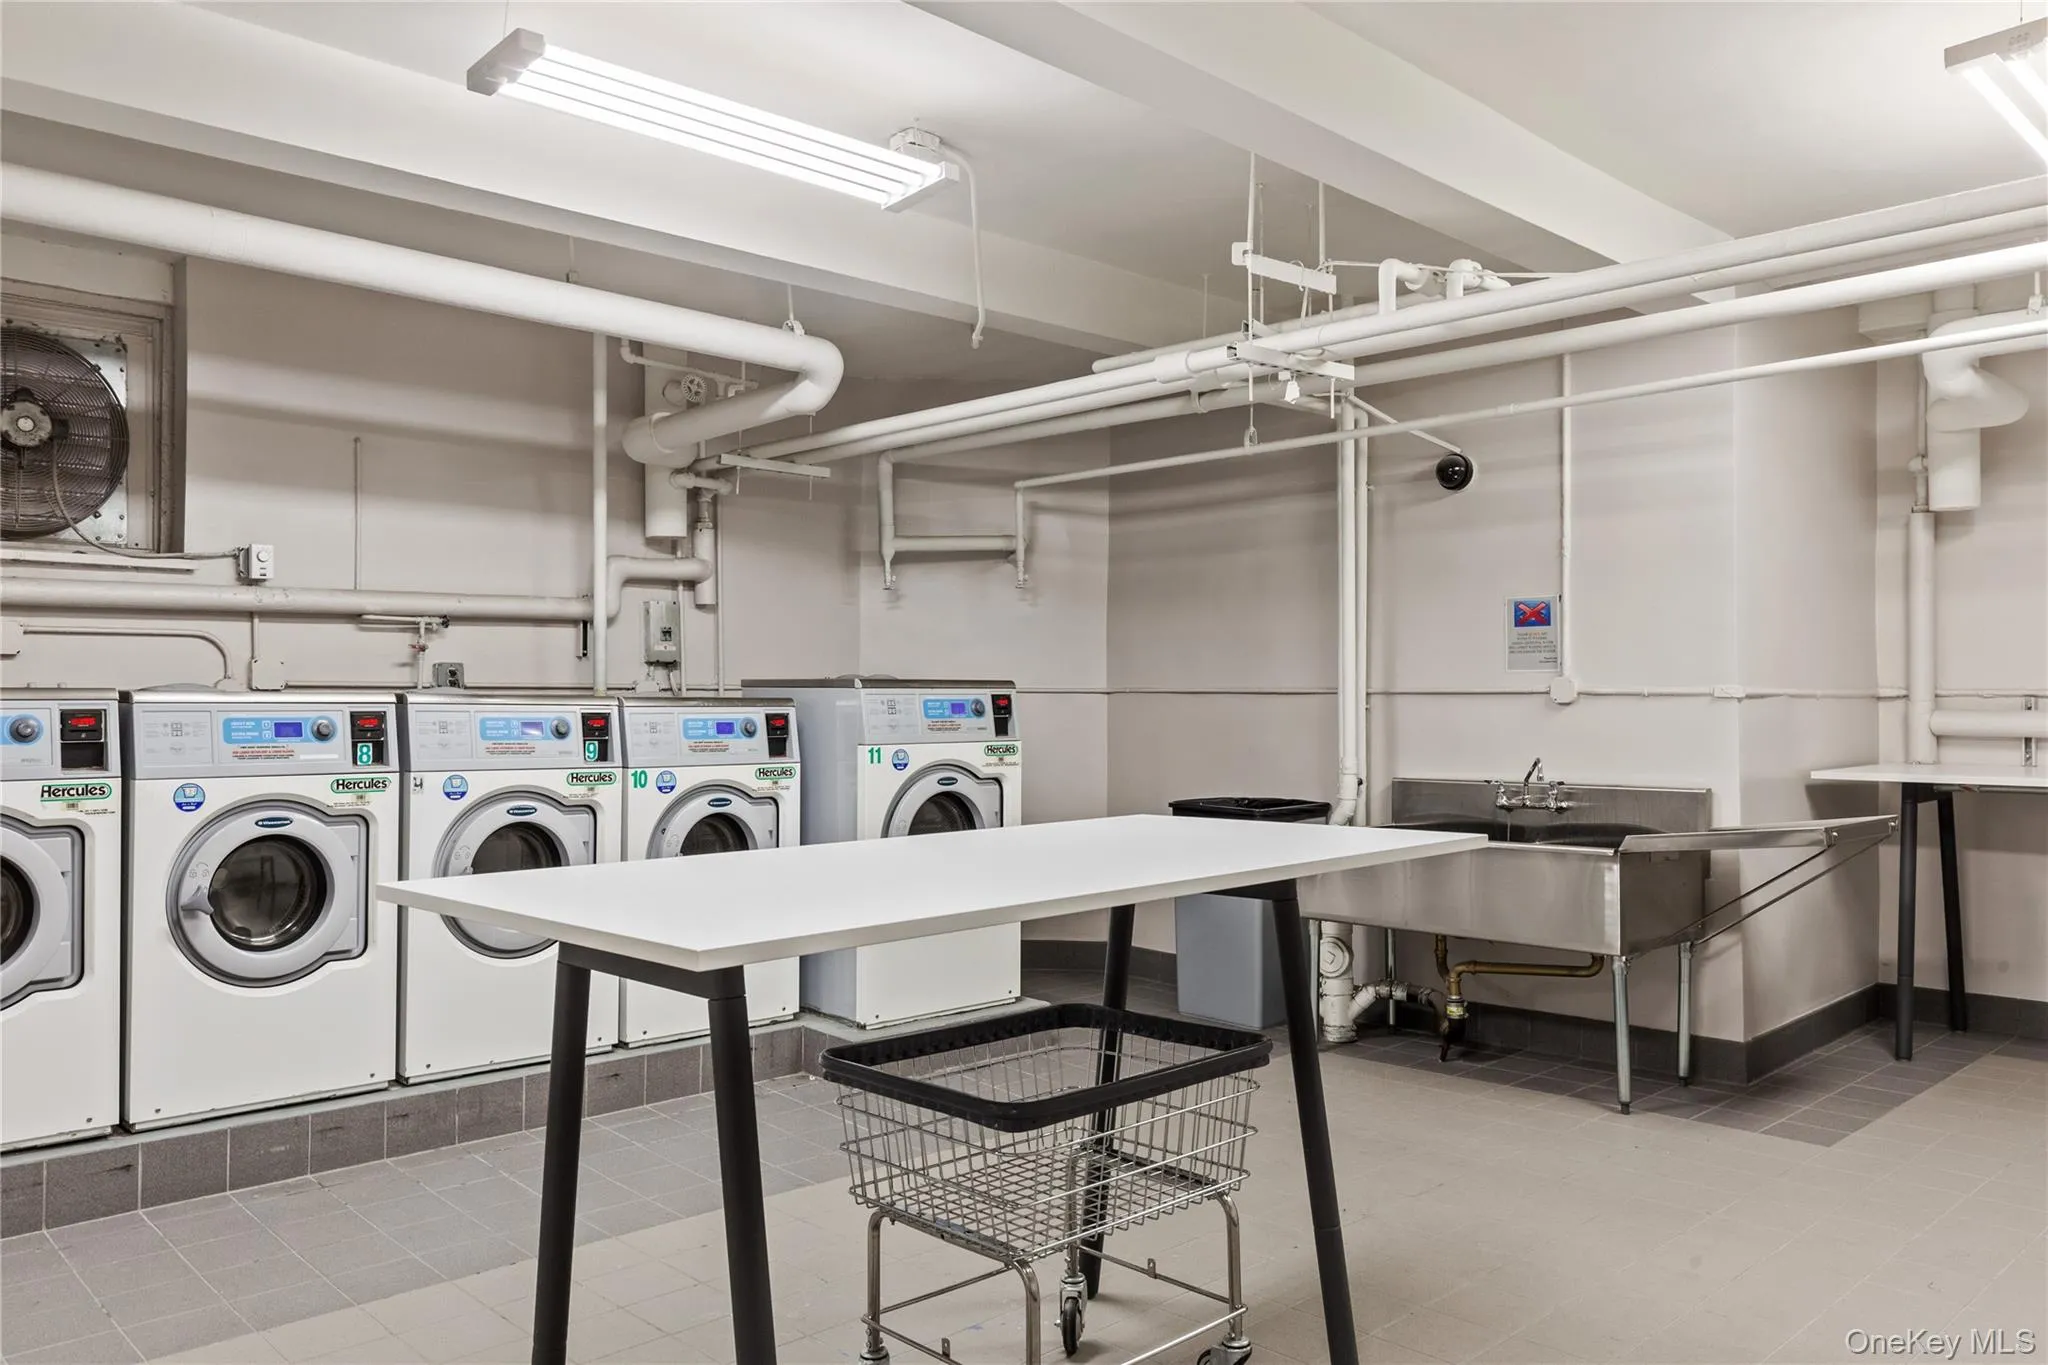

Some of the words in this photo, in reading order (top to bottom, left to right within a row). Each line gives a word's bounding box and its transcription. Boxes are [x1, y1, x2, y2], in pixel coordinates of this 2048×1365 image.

[358, 744, 372, 765] 8
[587, 742, 598, 760] 9
[868, 747, 881, 764] 11
[570, 772, 613, 783] Hercules
[631, 770, 648, 788] 10
[758, 767, 793, 778] Hercules
[41, 784, 106, 799] Hercules
[336, 778, 388, 791] Hercules
